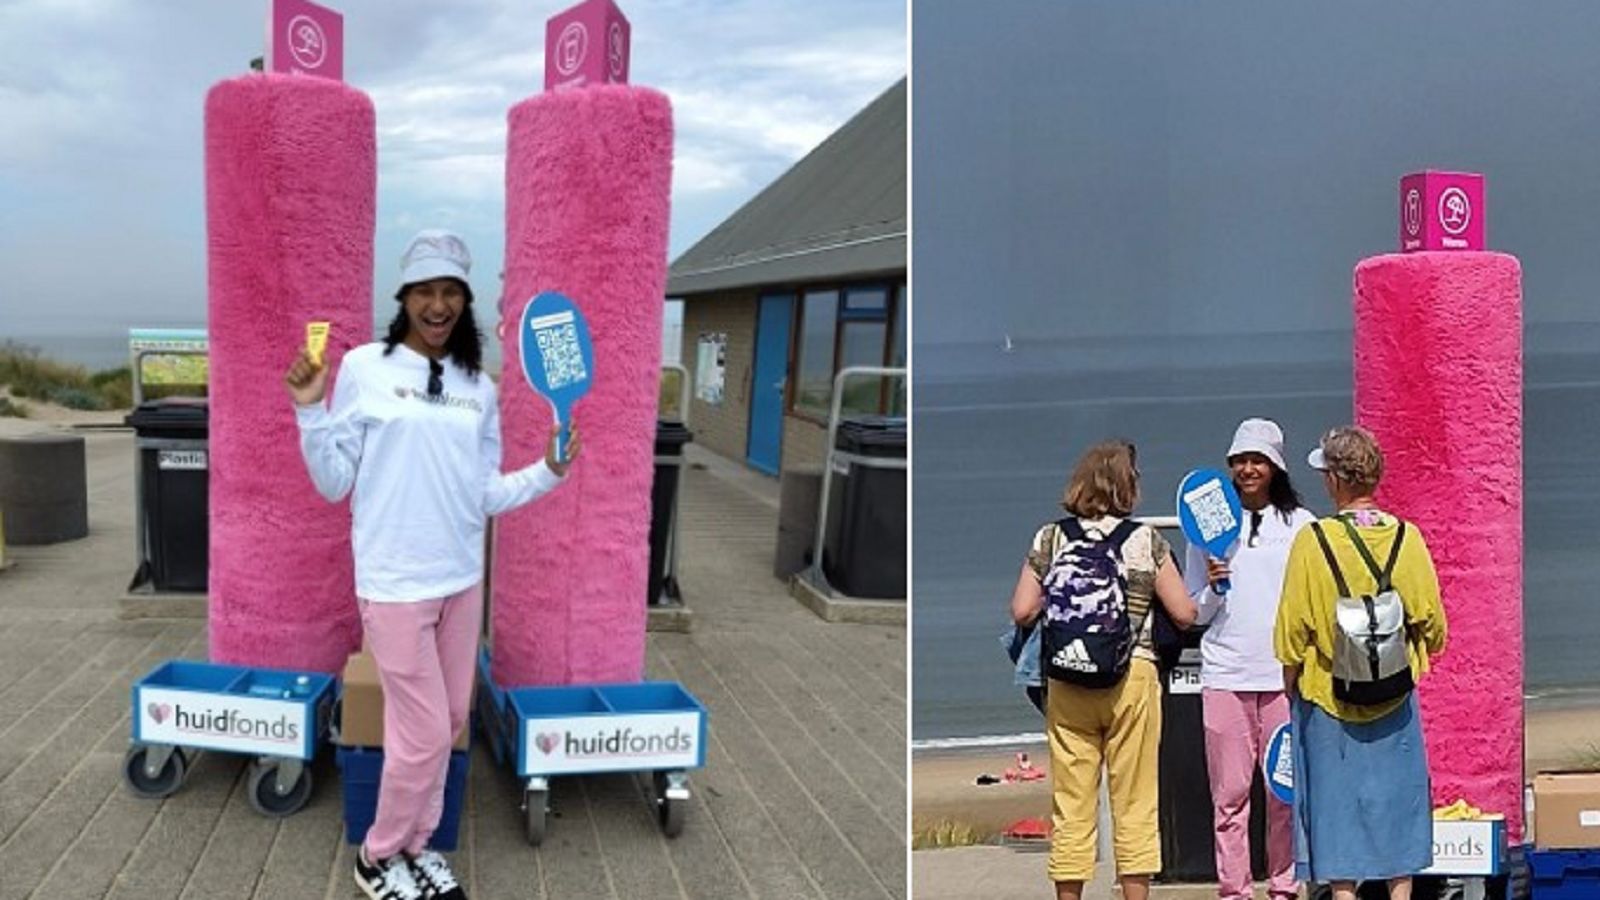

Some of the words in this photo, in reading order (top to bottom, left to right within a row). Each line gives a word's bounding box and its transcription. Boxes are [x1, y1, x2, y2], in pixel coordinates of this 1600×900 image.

[1052, 655, 1098, 673] adidas
[175, 704, 299, 740] huidfonds
[565, 727, 693, 755] huidfonds
